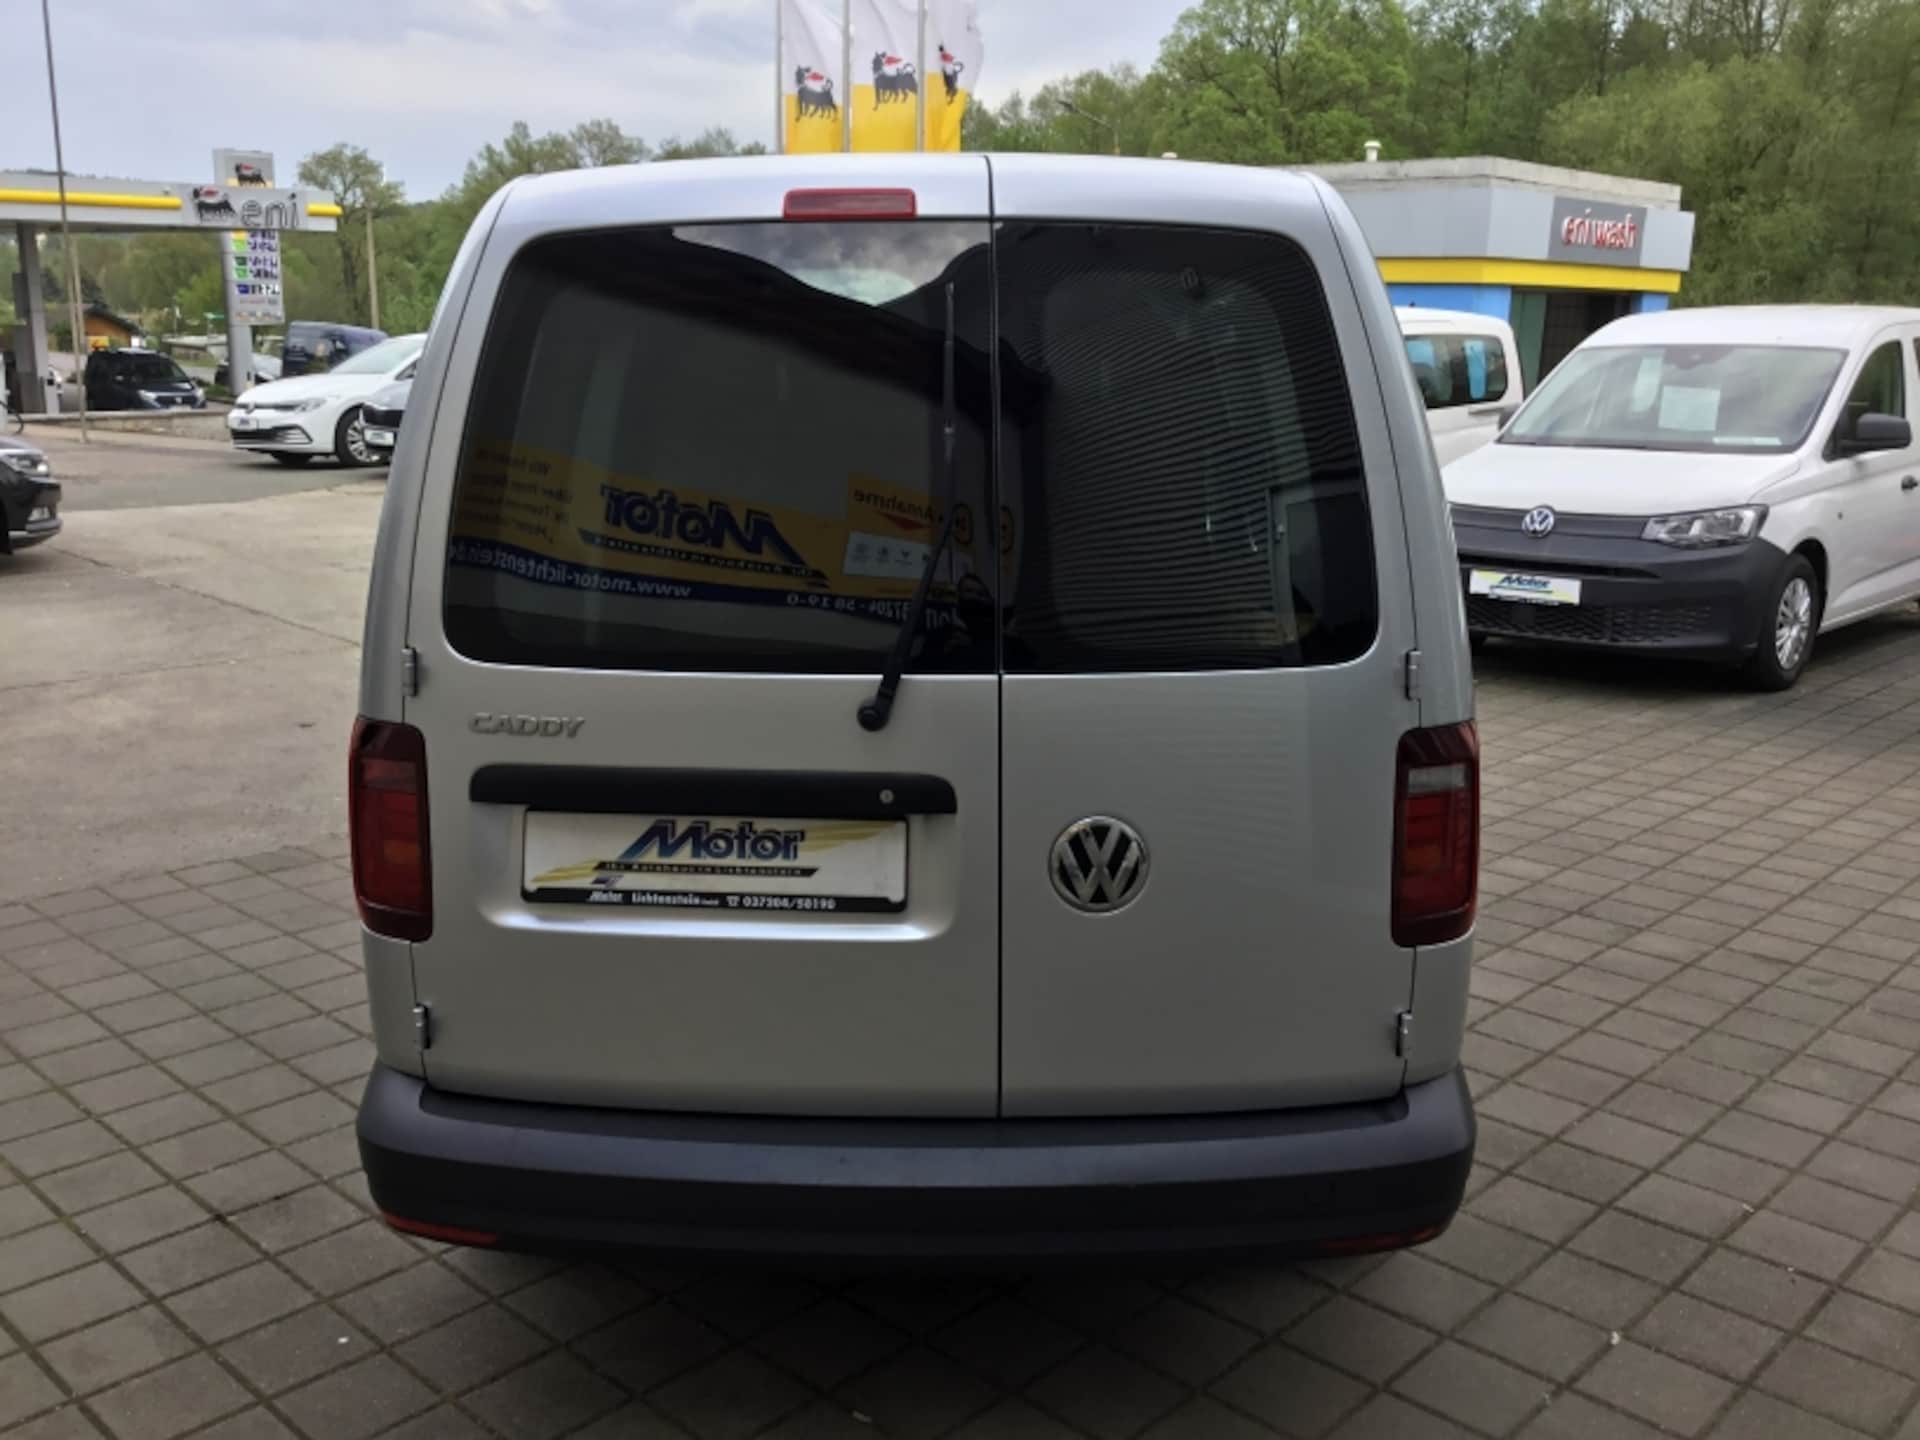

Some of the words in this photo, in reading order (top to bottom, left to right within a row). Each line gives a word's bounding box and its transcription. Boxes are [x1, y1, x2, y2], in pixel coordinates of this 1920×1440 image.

[241, 192, 299, 229] eni
[1562, 208, 1597, 247] eni
[1597, 213, 1637, 249] wash
[468, 711, 586, 738] CADDY
[617, 818, 806, 861] Motor
[588, 891, 622, 903] Motor
[632, 892, 700, 905] Lichtenstein
